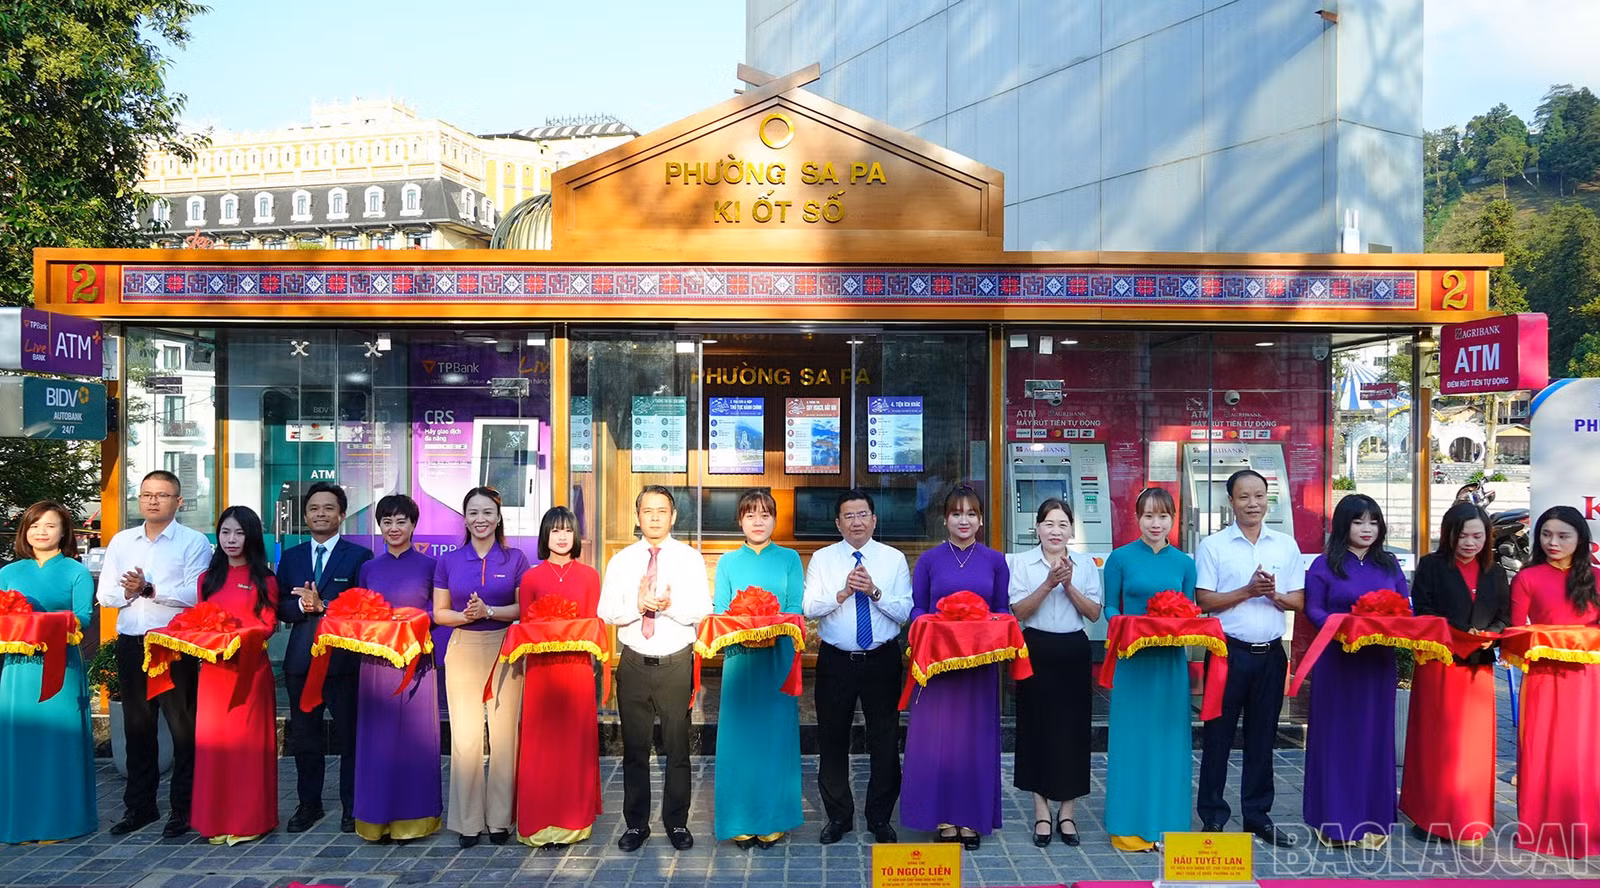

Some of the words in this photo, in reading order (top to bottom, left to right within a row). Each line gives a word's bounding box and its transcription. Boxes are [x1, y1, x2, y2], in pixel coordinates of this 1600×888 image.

[665, 154, 786, 185] PHƯỜNG
[801, 161, 839, 185] SA
[850, 161, 887, 185] PA
[714, 201, 740, 223] KI
[752, 190, 792, 223] ỐT
[802, 190, 846, 223] SỐ
[72, 264, 98, 302] 2
[1442, 270, 1468, 309] 2
[1462, 325, 1500, 339] AGRIBANK
[32, 353, 46, 361] BANK
[1454, 343, 1500, 374] ATM
[438, 362, 479, 373] TPBank
[518, 356, 549, 375] Liv
[690, 361, 791, 385] PHƯỜNG
[800, 367, 831, 386] SA
[840, 367, 872, 385] PA
[46, 387, 78, 407] BIDV
[53, 411, 82, 421] AUTOBANK
[424, 410, 455, 425] CRS
[1016, 409, 1036, 418] ATM
[61, 425, 75, 434] 24/7
[1574, 419, 1600, 432] PH
[310, 470, 335, 479] ATM
[1224, 857, 1242, 865] LAN
[881, 866, 894, 876] TÔ
[897, 867, 925, 877] NGỌC
